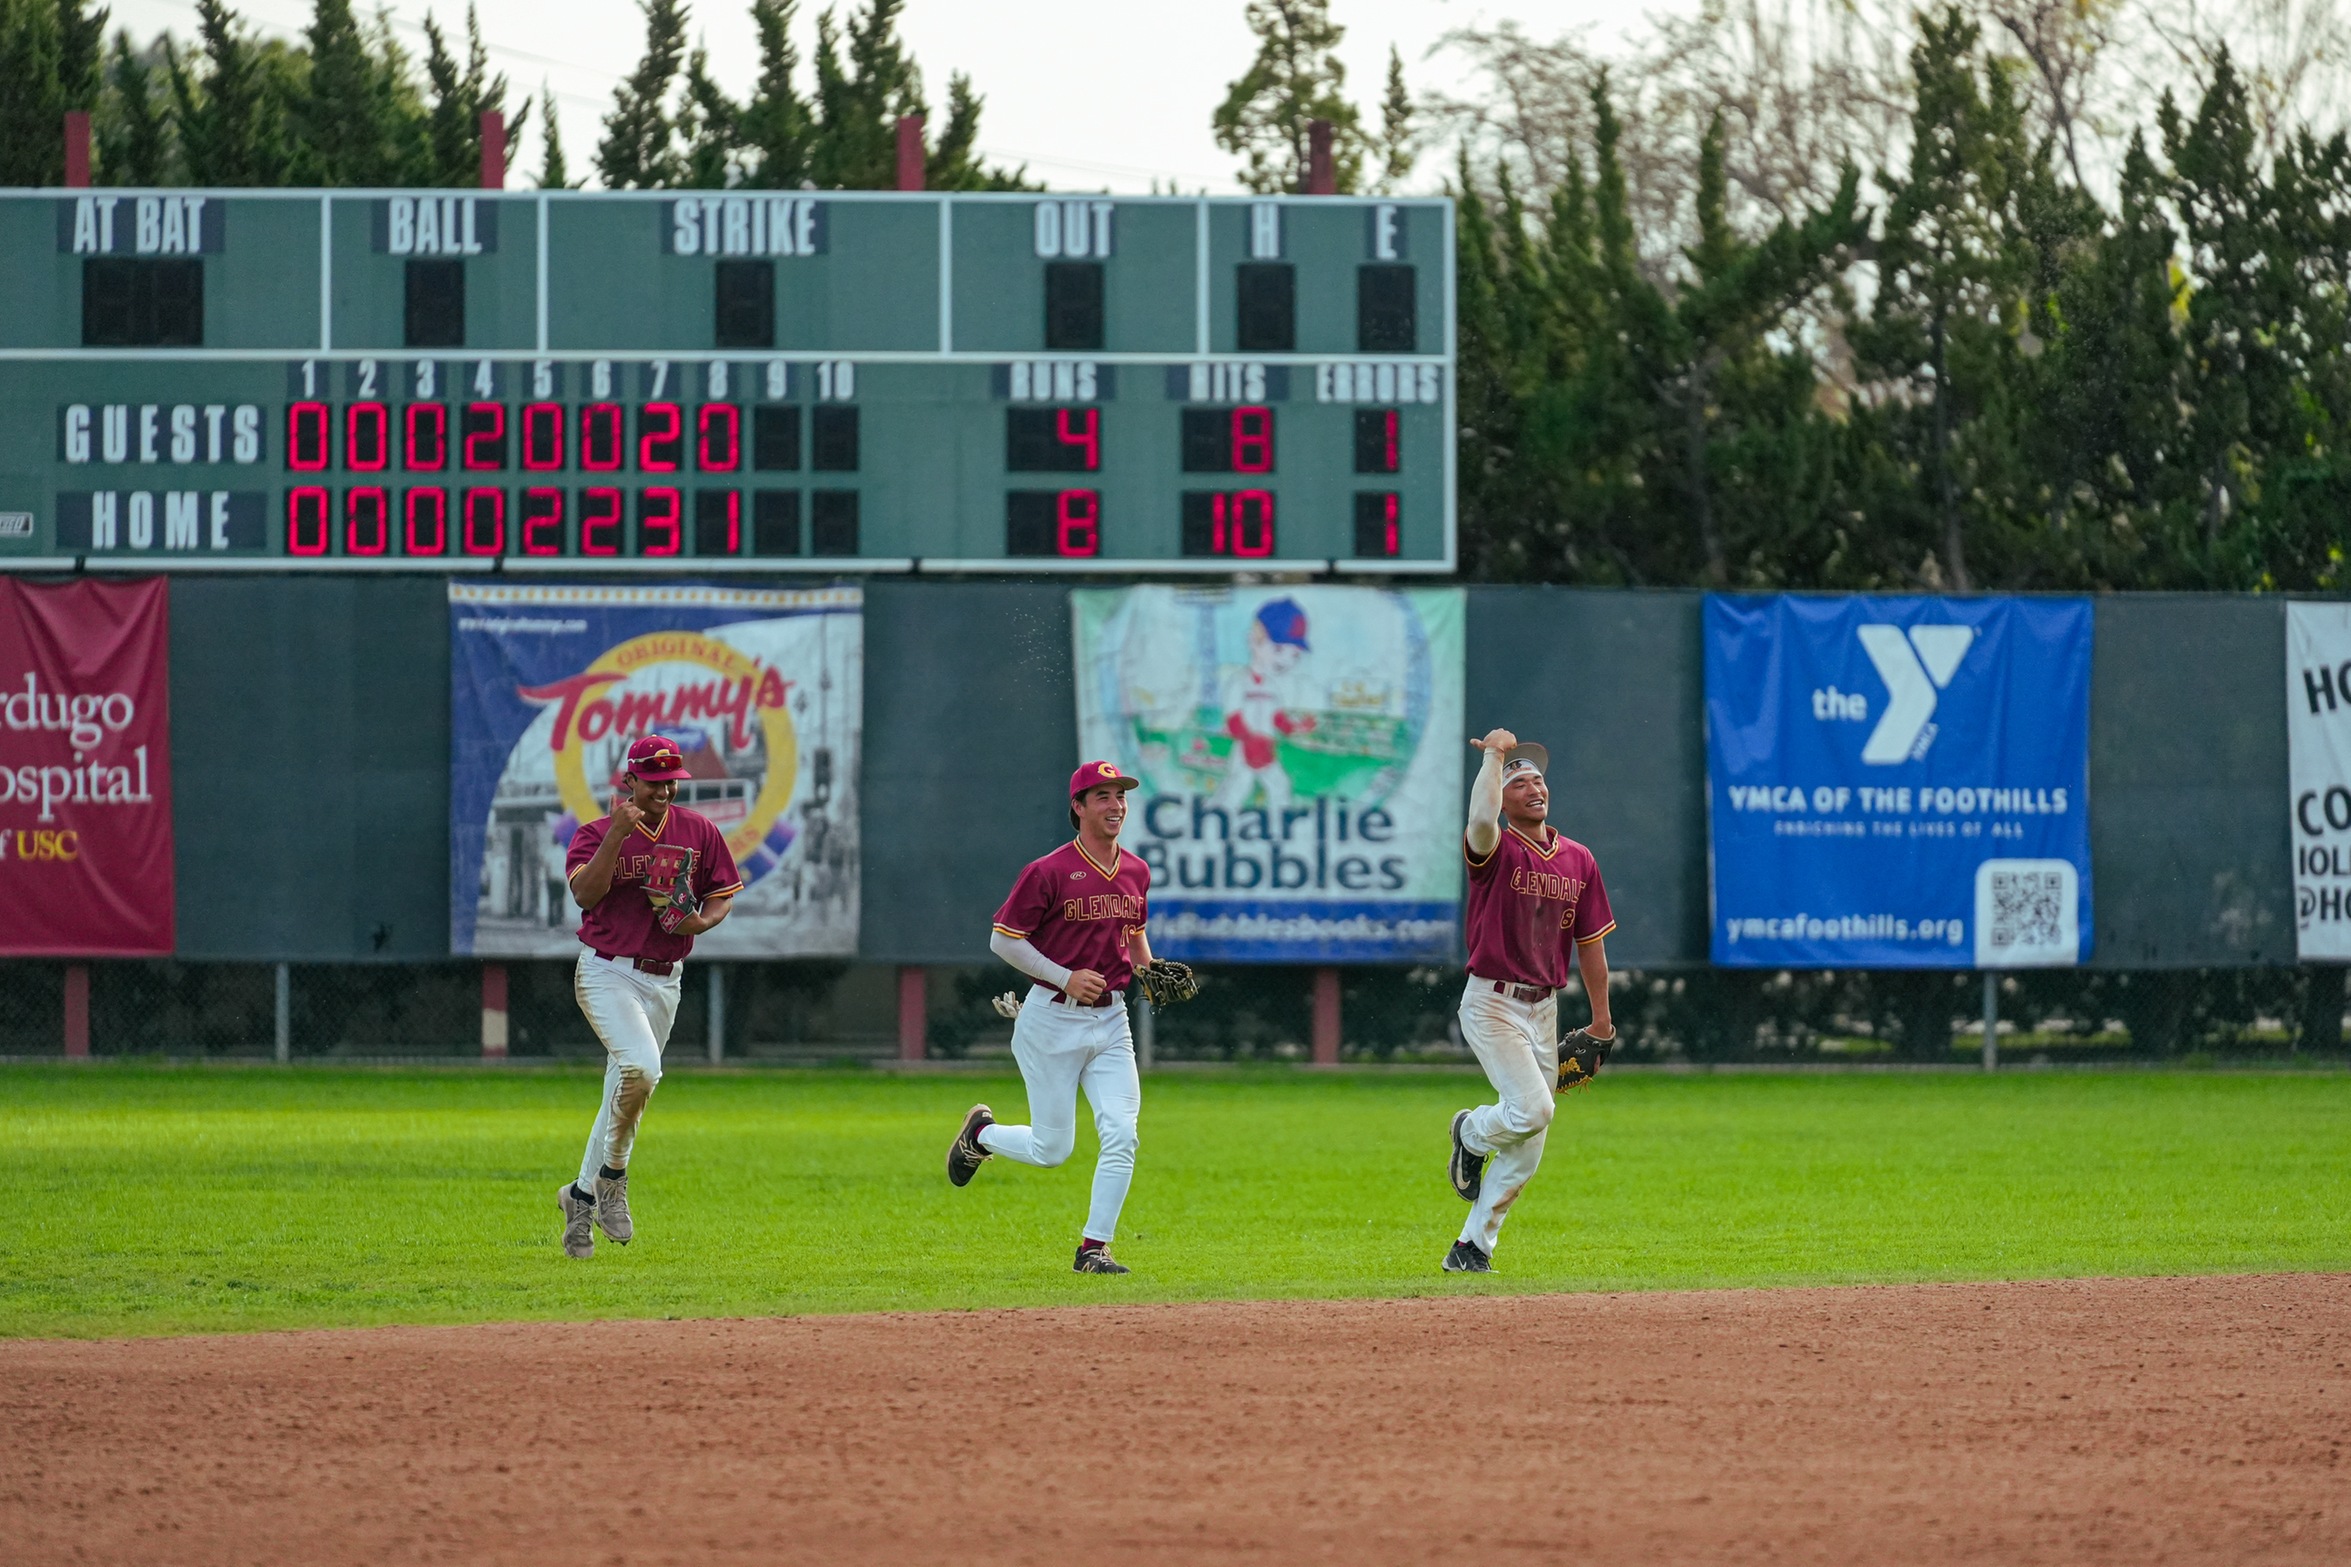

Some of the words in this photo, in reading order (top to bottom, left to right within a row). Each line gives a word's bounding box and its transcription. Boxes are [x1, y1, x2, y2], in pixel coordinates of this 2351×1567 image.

[73, 198, 117, 253] AT
[136, 198, 205, 253] BAT
[389, 198, 482, 254] BALL
[673, 199, 816, 255] STRIKE
[1034, 202, 1114, 258] OUT
[1252, 204, 1279, 258] H
[1376, 206, 1398, 259] E
[302, 359, 315, 399] 1
[358, 359, 377, 399] 2
[416, 359, 435, 399] 3
[474, 360, 493, 399] 4
[534, 360, 553, 400] 5
[592, 360, 611, 400] 6
[651, 360, 670, 400] 7
[708, 360, 729, 400] 8
[767, 360, 787, 400] 9
[817, 360, 854, 400] 10
[1189, 363, 1265, 401] HITS
[1315, 364, 1438, 402] ERRORS
[65, 405, 259, 463] GUESTS
[288, 403, 328, 472] 0
[347, 403, 387, 472] 0
[405, 403, 446, 472] 0
[465, 403, 505, 472] 2
[522, 403, 563, 472] 0
[581, 403, 622, 472] 0
[640, 403, 681, 472] 2
[699, 403, 739, 472] 0
[1056, 408, 1099, 470] 4
[1231, 406, 1272, 474] 8
[1385, 410, 1399, 471] 1
[92, 491, 229, 549] HOME
[288, 486, 328, 556] 0
[347, 486, 387, 556] 0
[405, 486, 446, 556] 0
[465, 486, 505, 556] 0
[523, 487, 563, 556] 2
[581, 487, 622, 556] 2
[643, 487, 681, 556] 3
[727, 491, 739, 556] 1
[1057, 489, 1098, 558] 8
[1212, 489, 1273, 558] 10
[1385, 493, 1399, 555] 1
[616, 638, 734, 669] ORIGINAL
[516, 654, 796, 751] Tommy's
[1812, 686, 1868, 720] the
[1098, 763, 1116, 779] G
[1142, 793, 1395, 842] Charlie
[1728, 785, 1807, 813] YMCA
[1813, 786, 1850, 813] OF
[1858, 786, 1911, 813] THE
[1919, 787, 2067, 814] FOOTHILLS
[17, 830, 78, 861] USC
[1872, 820, 1902, 836] THE
[1961, 820, 1981, 837] OF
[1991, 821, 2023, 839] ALL
[1138, 842, 1407, 891] Bubbles
[1560, 909, 1575, 929] 8
[1726, 913, 1963, 945] ymcafoothills.org
